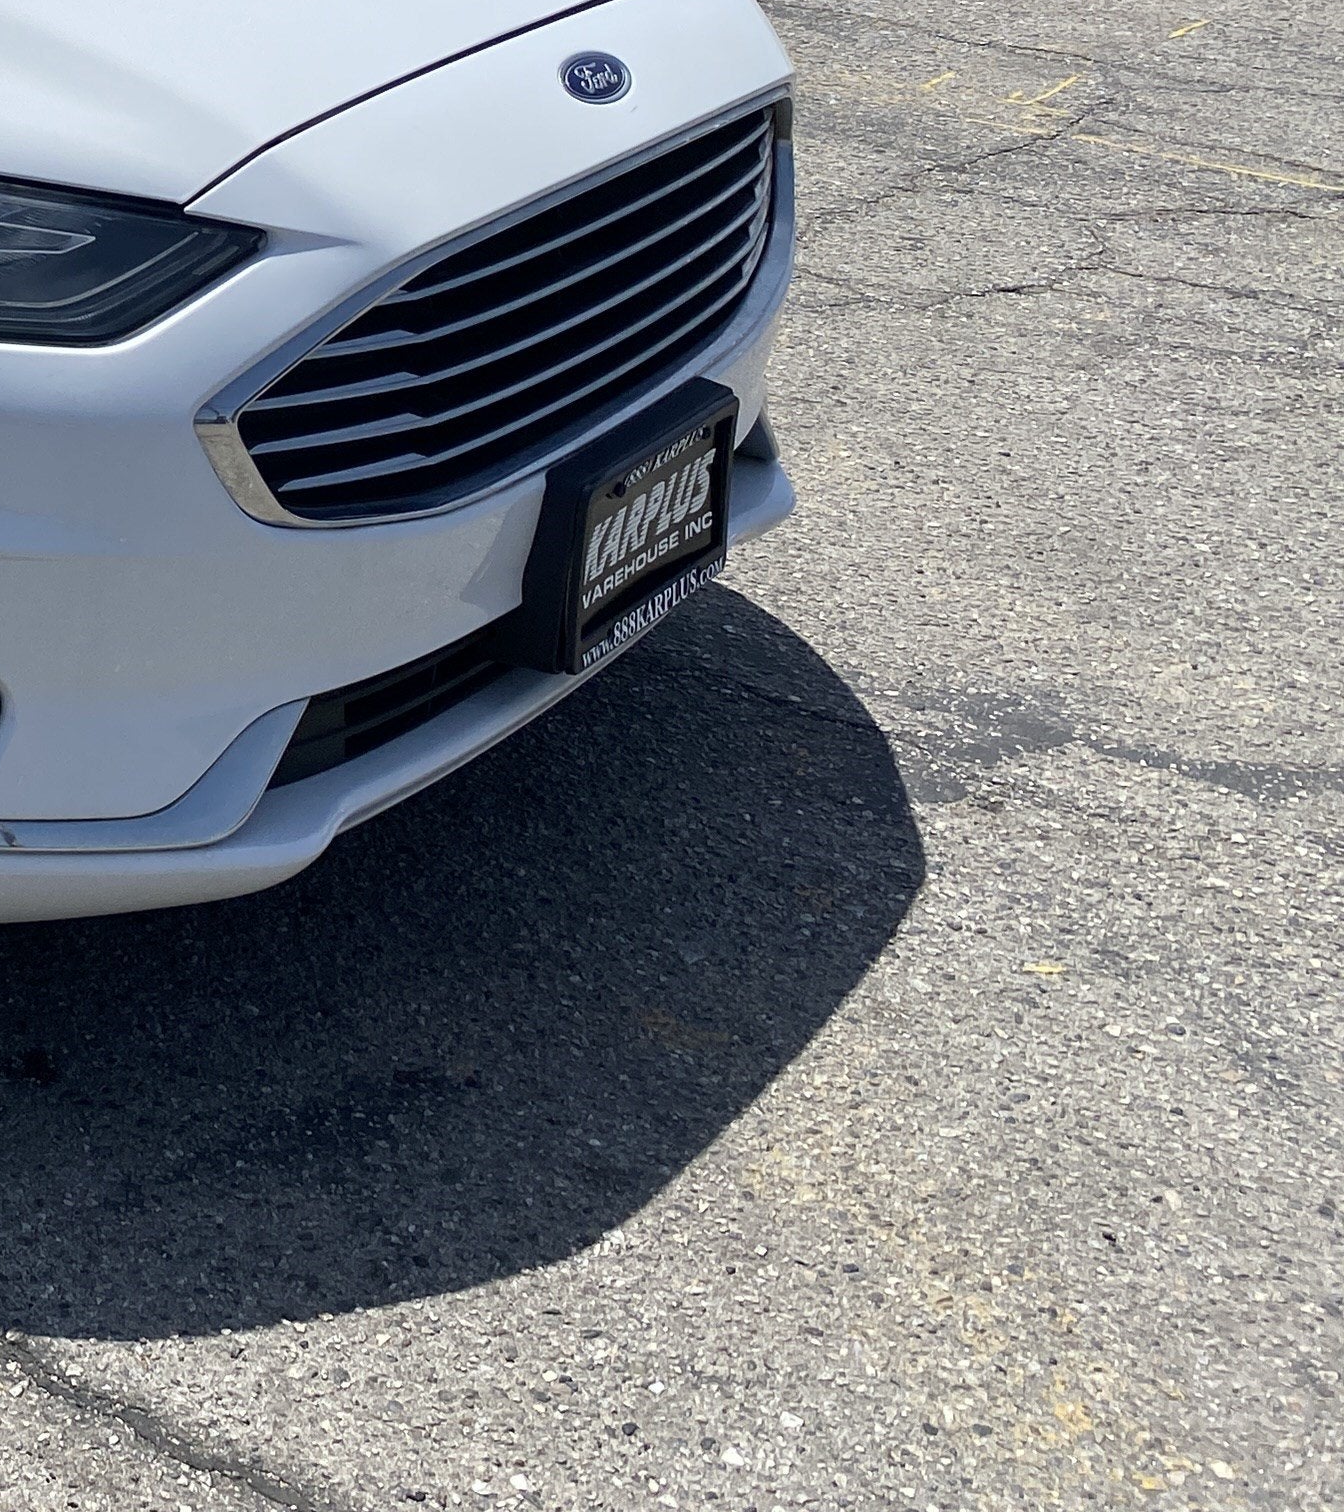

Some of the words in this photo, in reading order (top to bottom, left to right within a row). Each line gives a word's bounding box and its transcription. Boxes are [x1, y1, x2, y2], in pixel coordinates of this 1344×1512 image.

[573, 61, 619, 95] Ford
[583, 447, 717, 586] KARPLUS
[684, 511, 713, 541] INC
